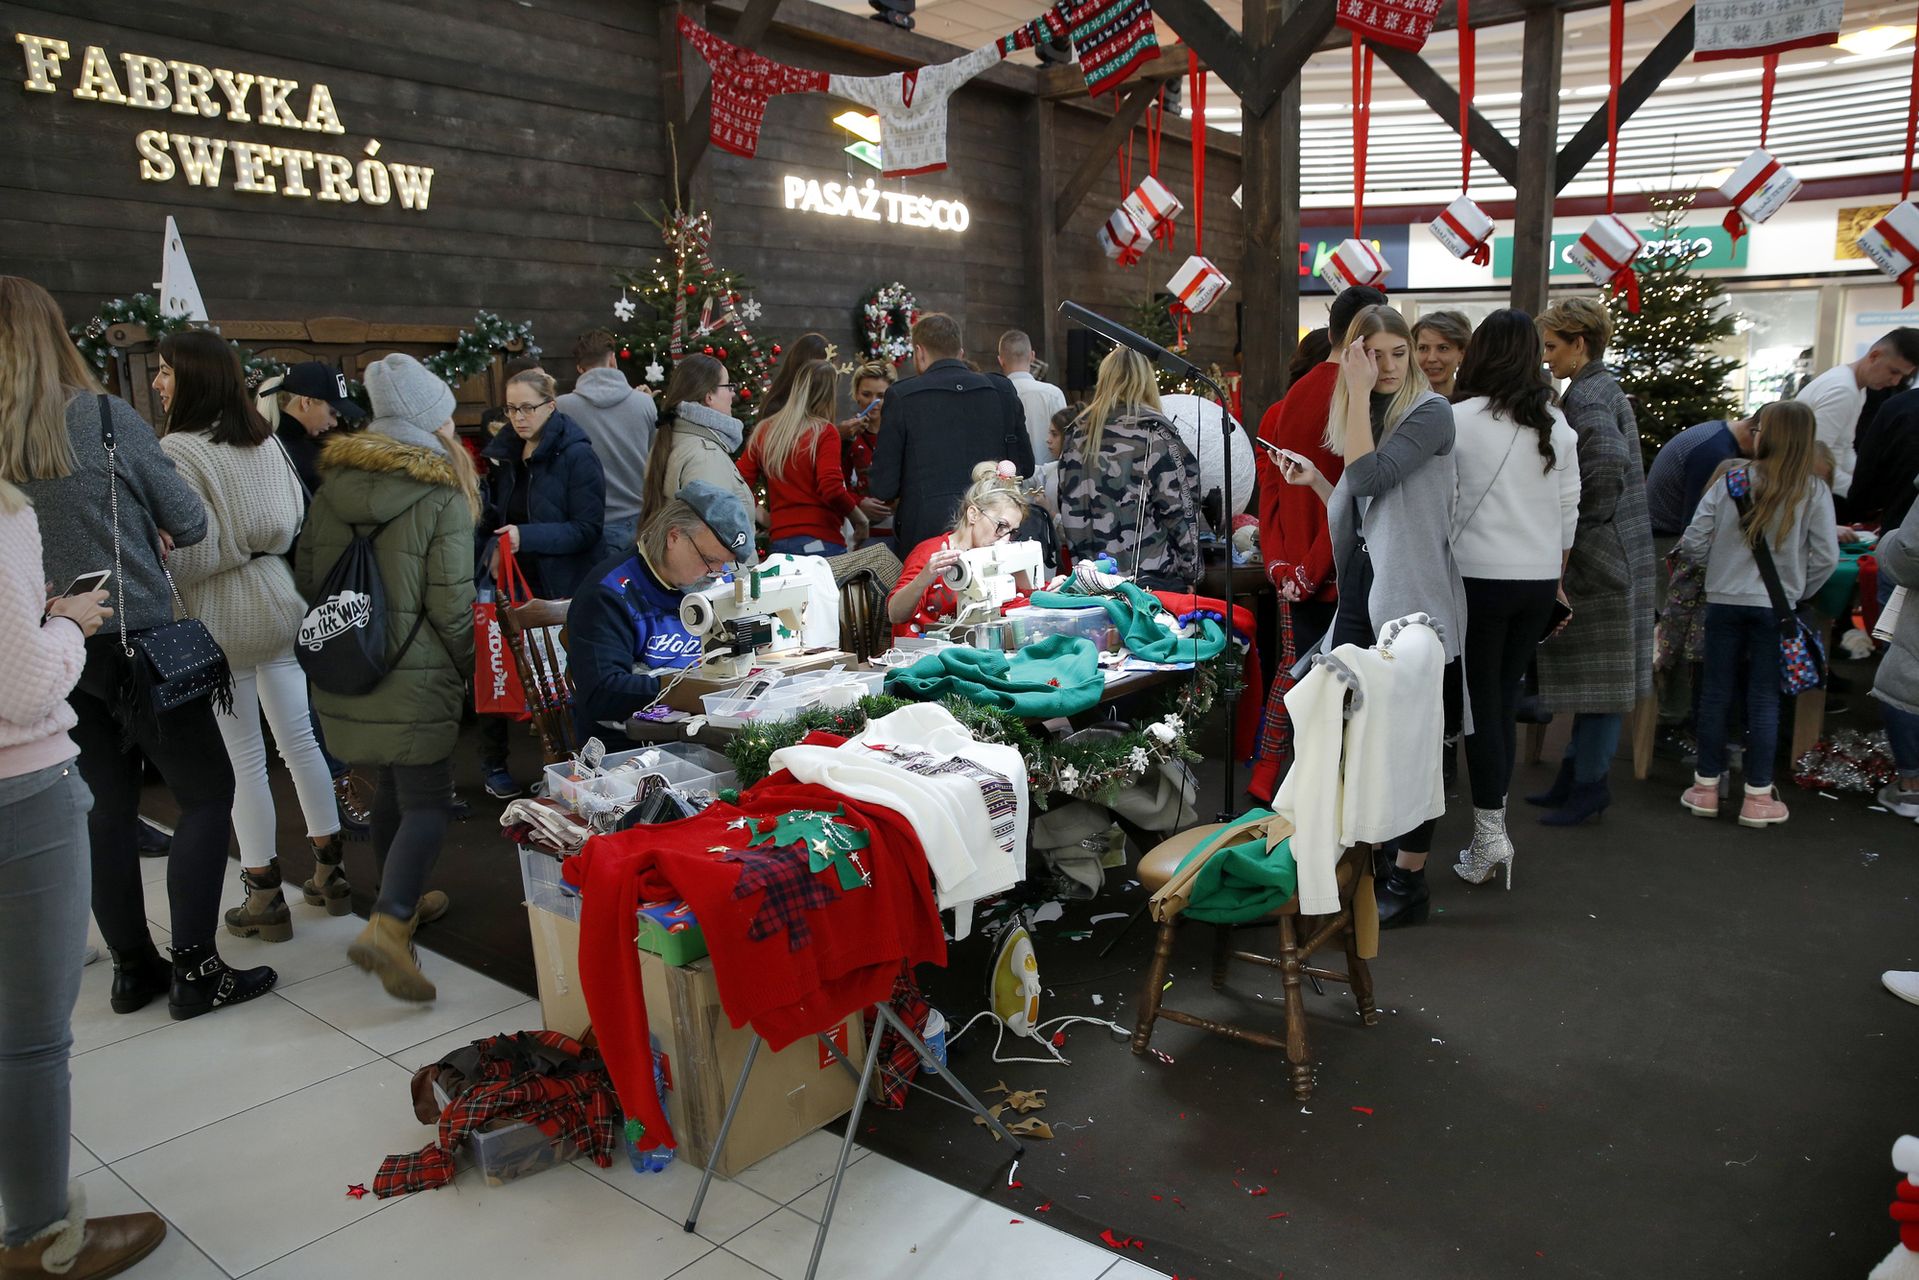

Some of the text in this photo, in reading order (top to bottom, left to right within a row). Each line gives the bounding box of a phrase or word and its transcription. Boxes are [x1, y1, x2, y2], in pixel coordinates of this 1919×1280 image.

[15, 32, 346, 135] FABRYKA
[136, 127, 434, 210] SWETRÓW
[784, 176, 970, 232] PASAŻ TESCO
[1877, 255, 1897, 276] TESCO
[337, 596, 367, 625] WAL
